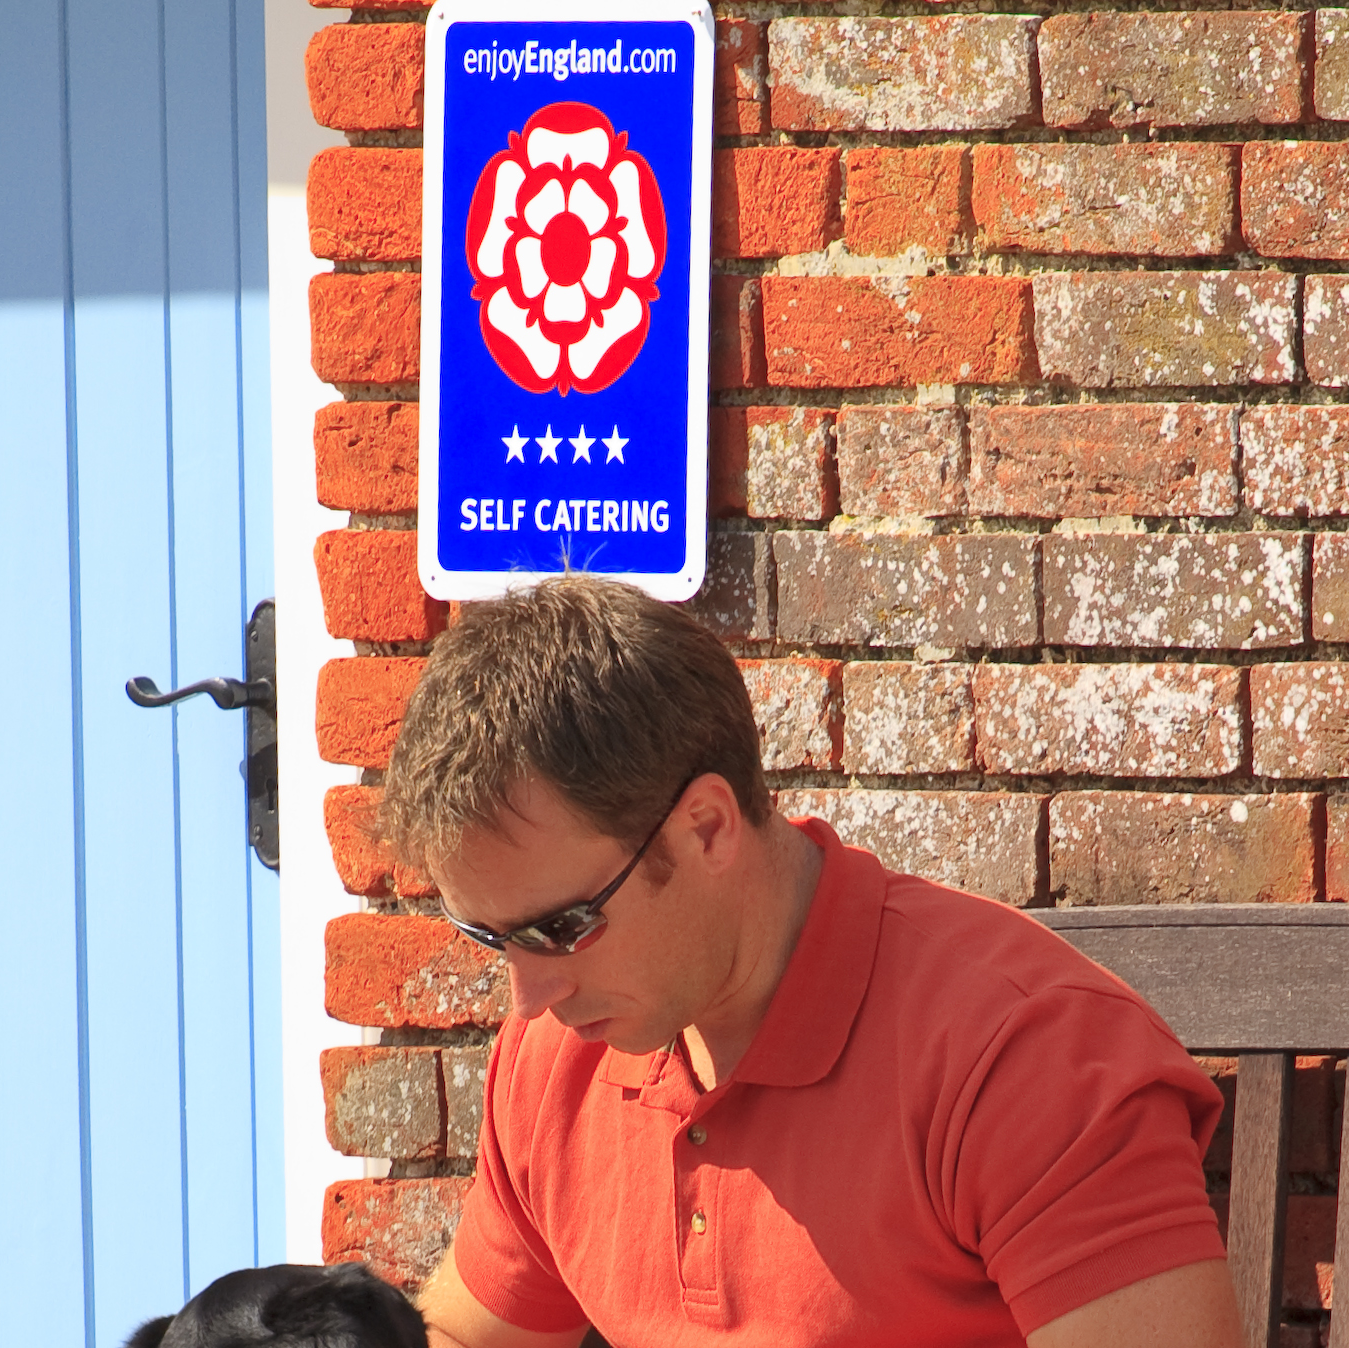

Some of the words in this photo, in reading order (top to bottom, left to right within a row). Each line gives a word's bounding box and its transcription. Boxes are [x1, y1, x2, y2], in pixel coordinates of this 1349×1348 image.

[463, 38, 677, 82] enjoyEngland.com
[459, 498, 527, 532] SELF
[534, 498, 670, 533] CATERING
